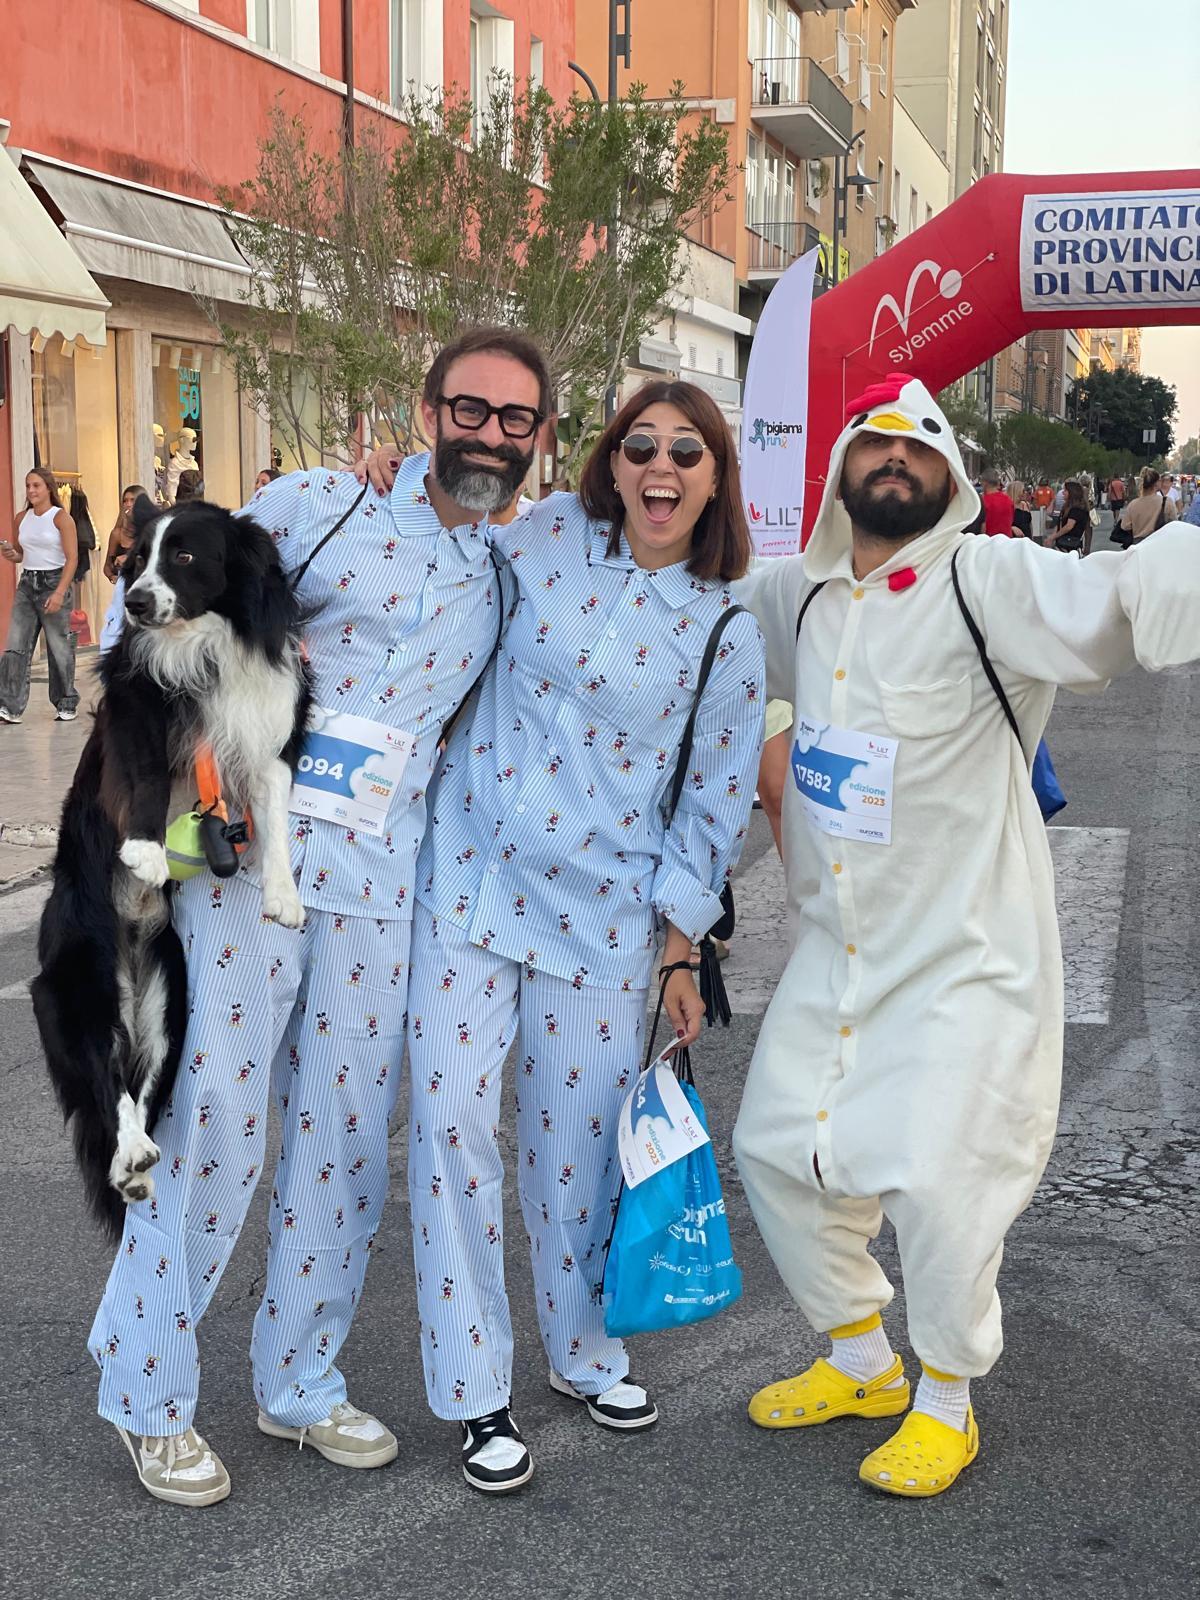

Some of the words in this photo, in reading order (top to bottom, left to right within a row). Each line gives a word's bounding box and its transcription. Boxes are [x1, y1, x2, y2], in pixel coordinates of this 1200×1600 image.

[1034, 205, 1200, 232] COMITAT
[1034, 272, 1070, 295] DI
[1085, 269, 1200, 294] LATINA
[889, 301, 973, 363] syemme
[180, 384, 200, 420] 50
[766, 421, 803, 436] pigiama
[766, 436, 781, 446] run
[297, 755, 343, 780] 094
[362, 772, 393, 788] edizione
[795, 763, 832, 793] 17582
[370, 785, 391, 797] 2023
[849, 783, 886, 796] edizione
[861, 794, 886, 808] 2023
[645, 1141, 660, 1166] 2023
[646, 1122, 667, 1161] edizione
